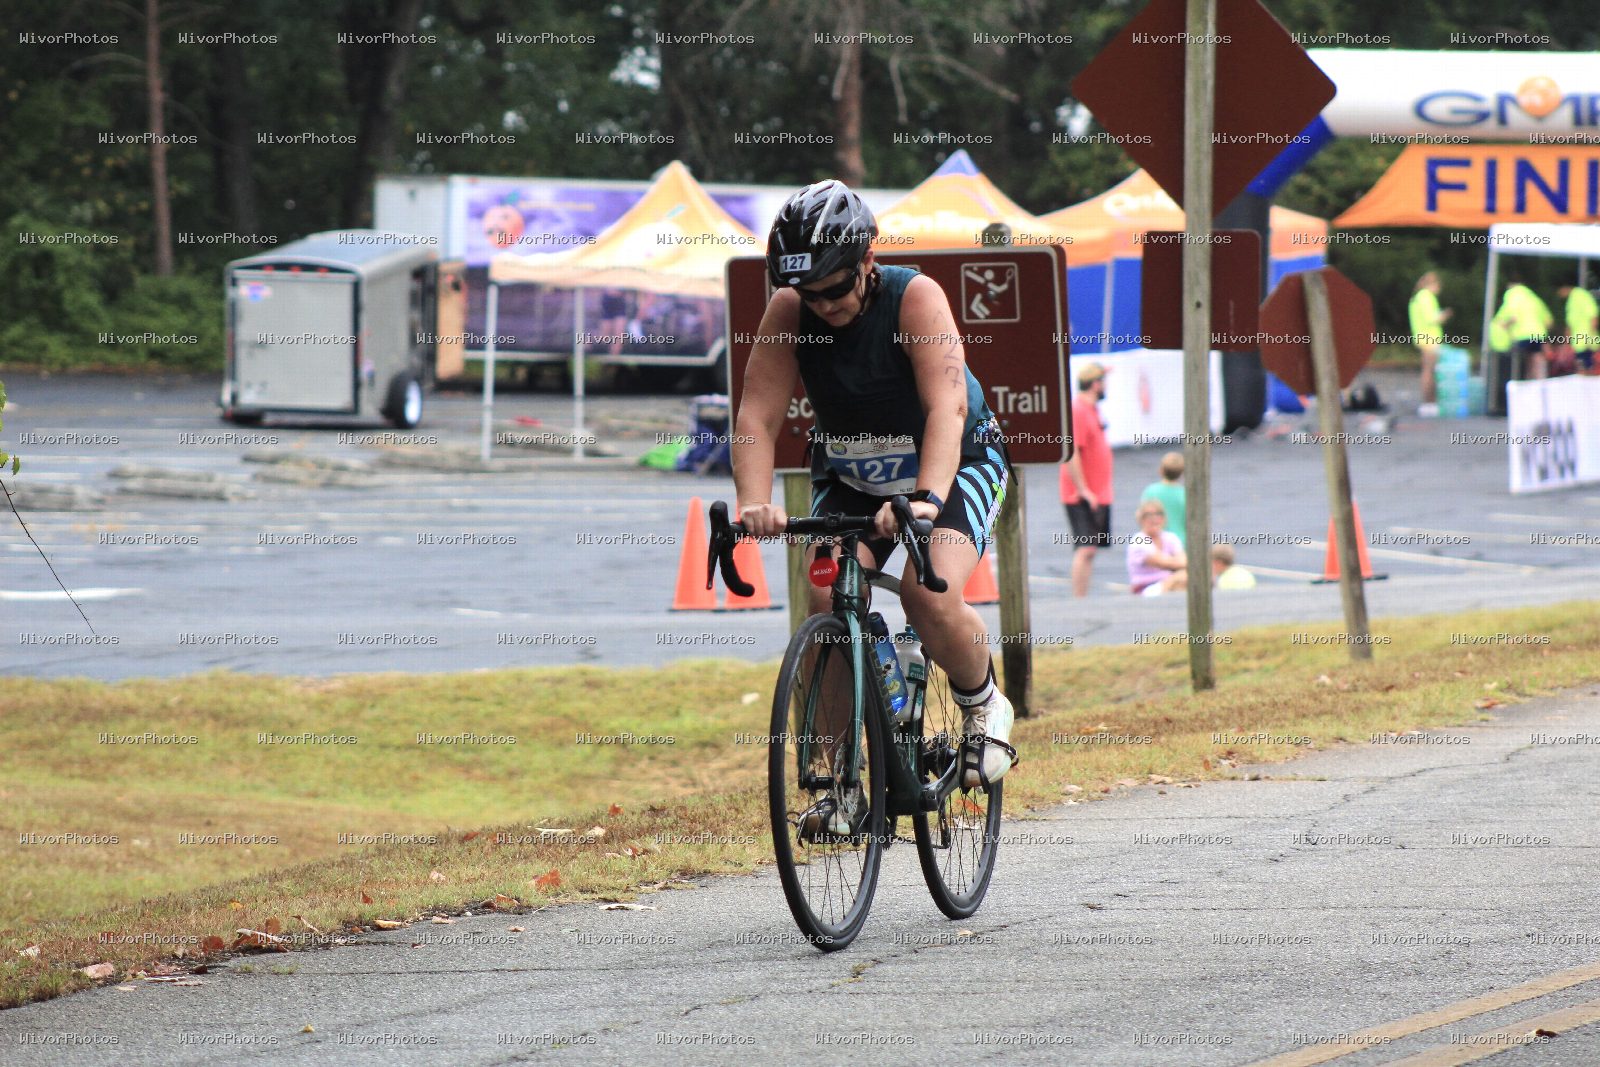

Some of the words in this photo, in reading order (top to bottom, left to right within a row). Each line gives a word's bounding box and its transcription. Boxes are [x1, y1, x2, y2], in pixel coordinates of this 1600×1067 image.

[1425, 157, 1600, 217] FINI
[782, 256, 806, 271] 127
[991, 384, 1048, 414] Trail
[845, 456, 905, 483] 127
